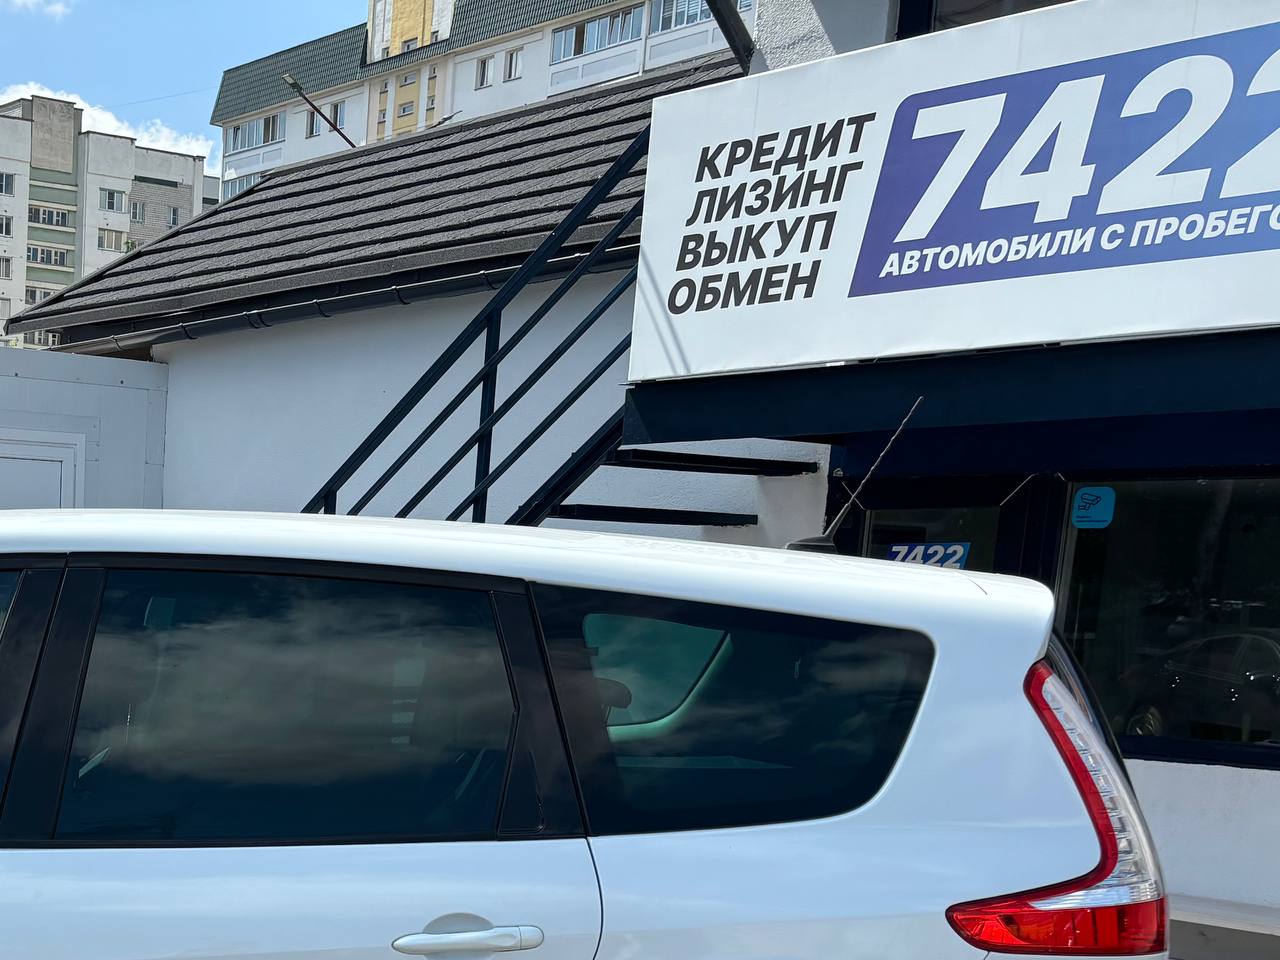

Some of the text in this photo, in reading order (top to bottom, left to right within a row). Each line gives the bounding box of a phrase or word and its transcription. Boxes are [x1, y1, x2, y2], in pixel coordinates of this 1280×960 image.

[695, 112, 877, 183] КРЕДИТ
[685, 161, 864, 227] ЛИЗИНГ
[675, 211, 837, 271] ВЫКУП
[879, 226, 1096, 278] АВТОМОБИЛИ
[1100, 223, 1125, 251] С
[667, 260, 821, 314] ОБМЕН
[891, 545, 964, 569] 7422
